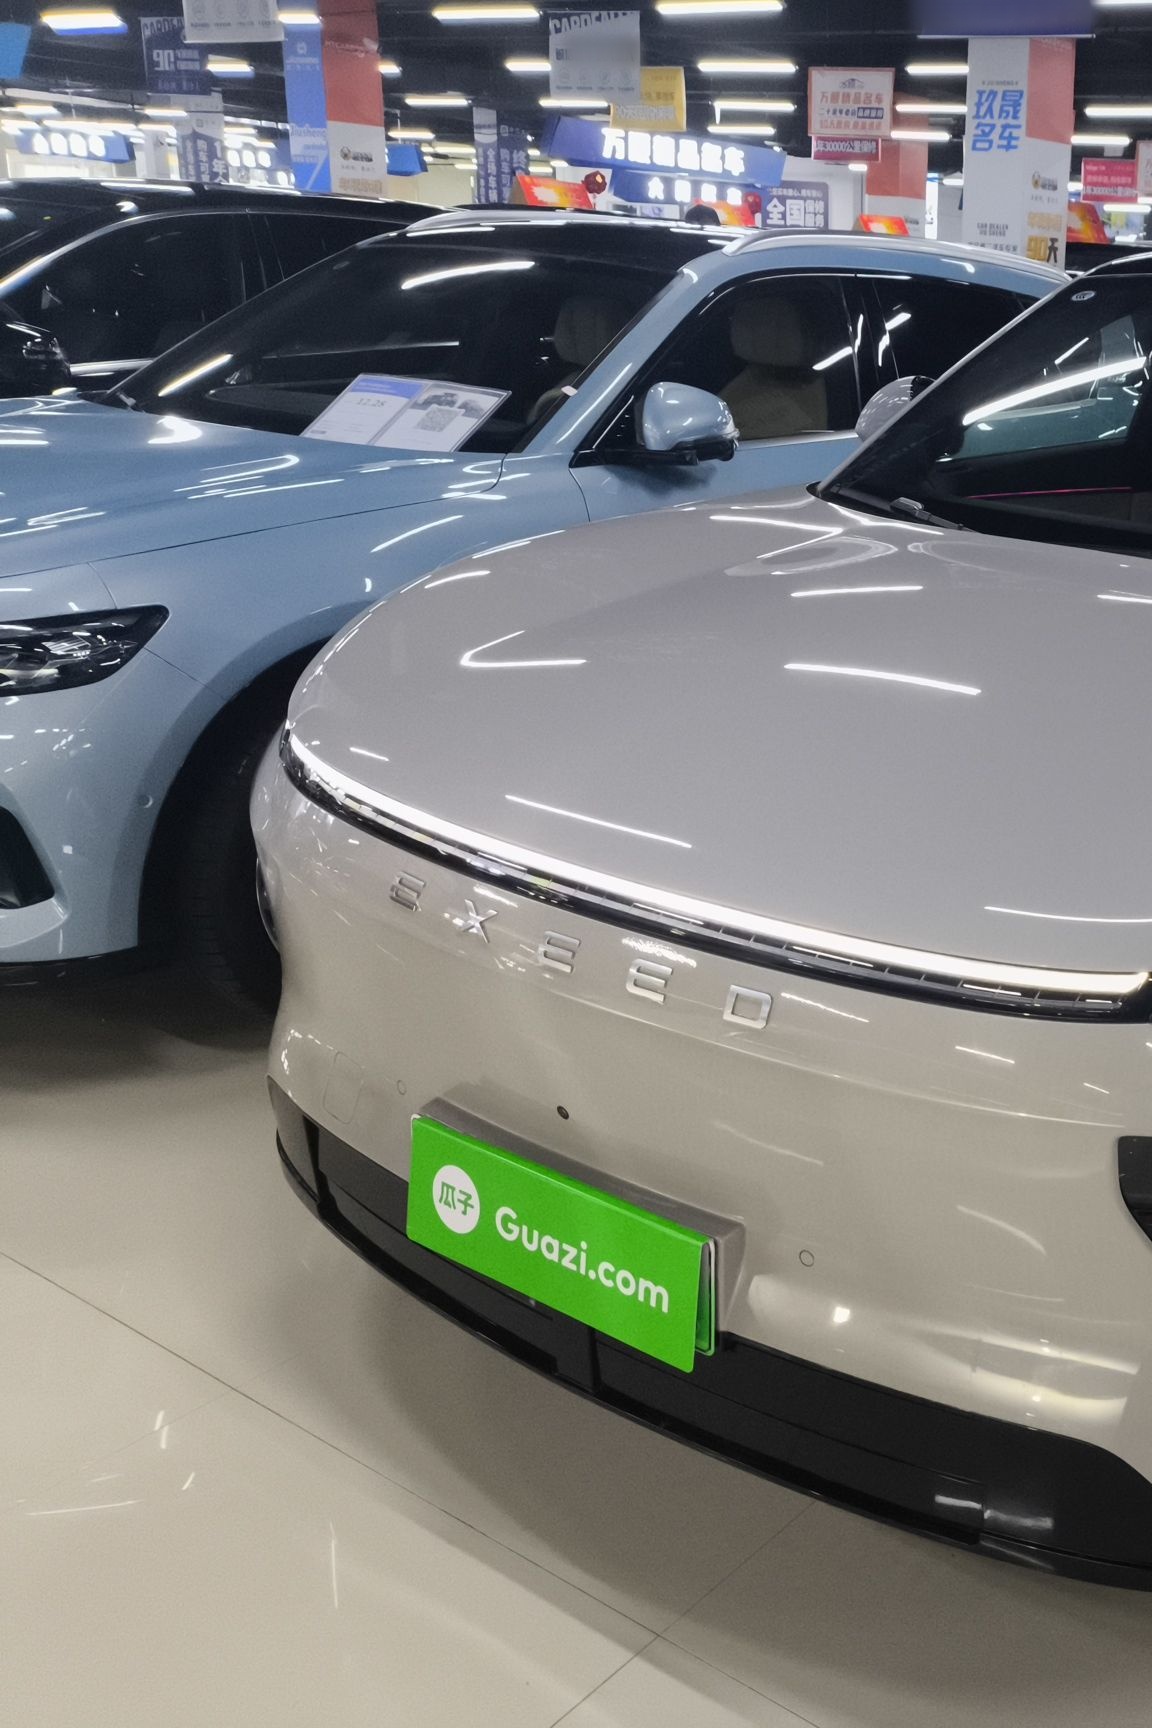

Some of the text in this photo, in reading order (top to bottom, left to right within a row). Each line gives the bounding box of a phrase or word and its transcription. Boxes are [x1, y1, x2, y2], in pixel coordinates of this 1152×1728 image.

[972, 89, 1024, 120] 玖晟
[971, 122, 1022, 152] 名车
[389, 871, 772, 1030] EXEED
[438, 1181, 475, 1216] 瓜子
[495, 1206, 669, 1313] Guazi.com
